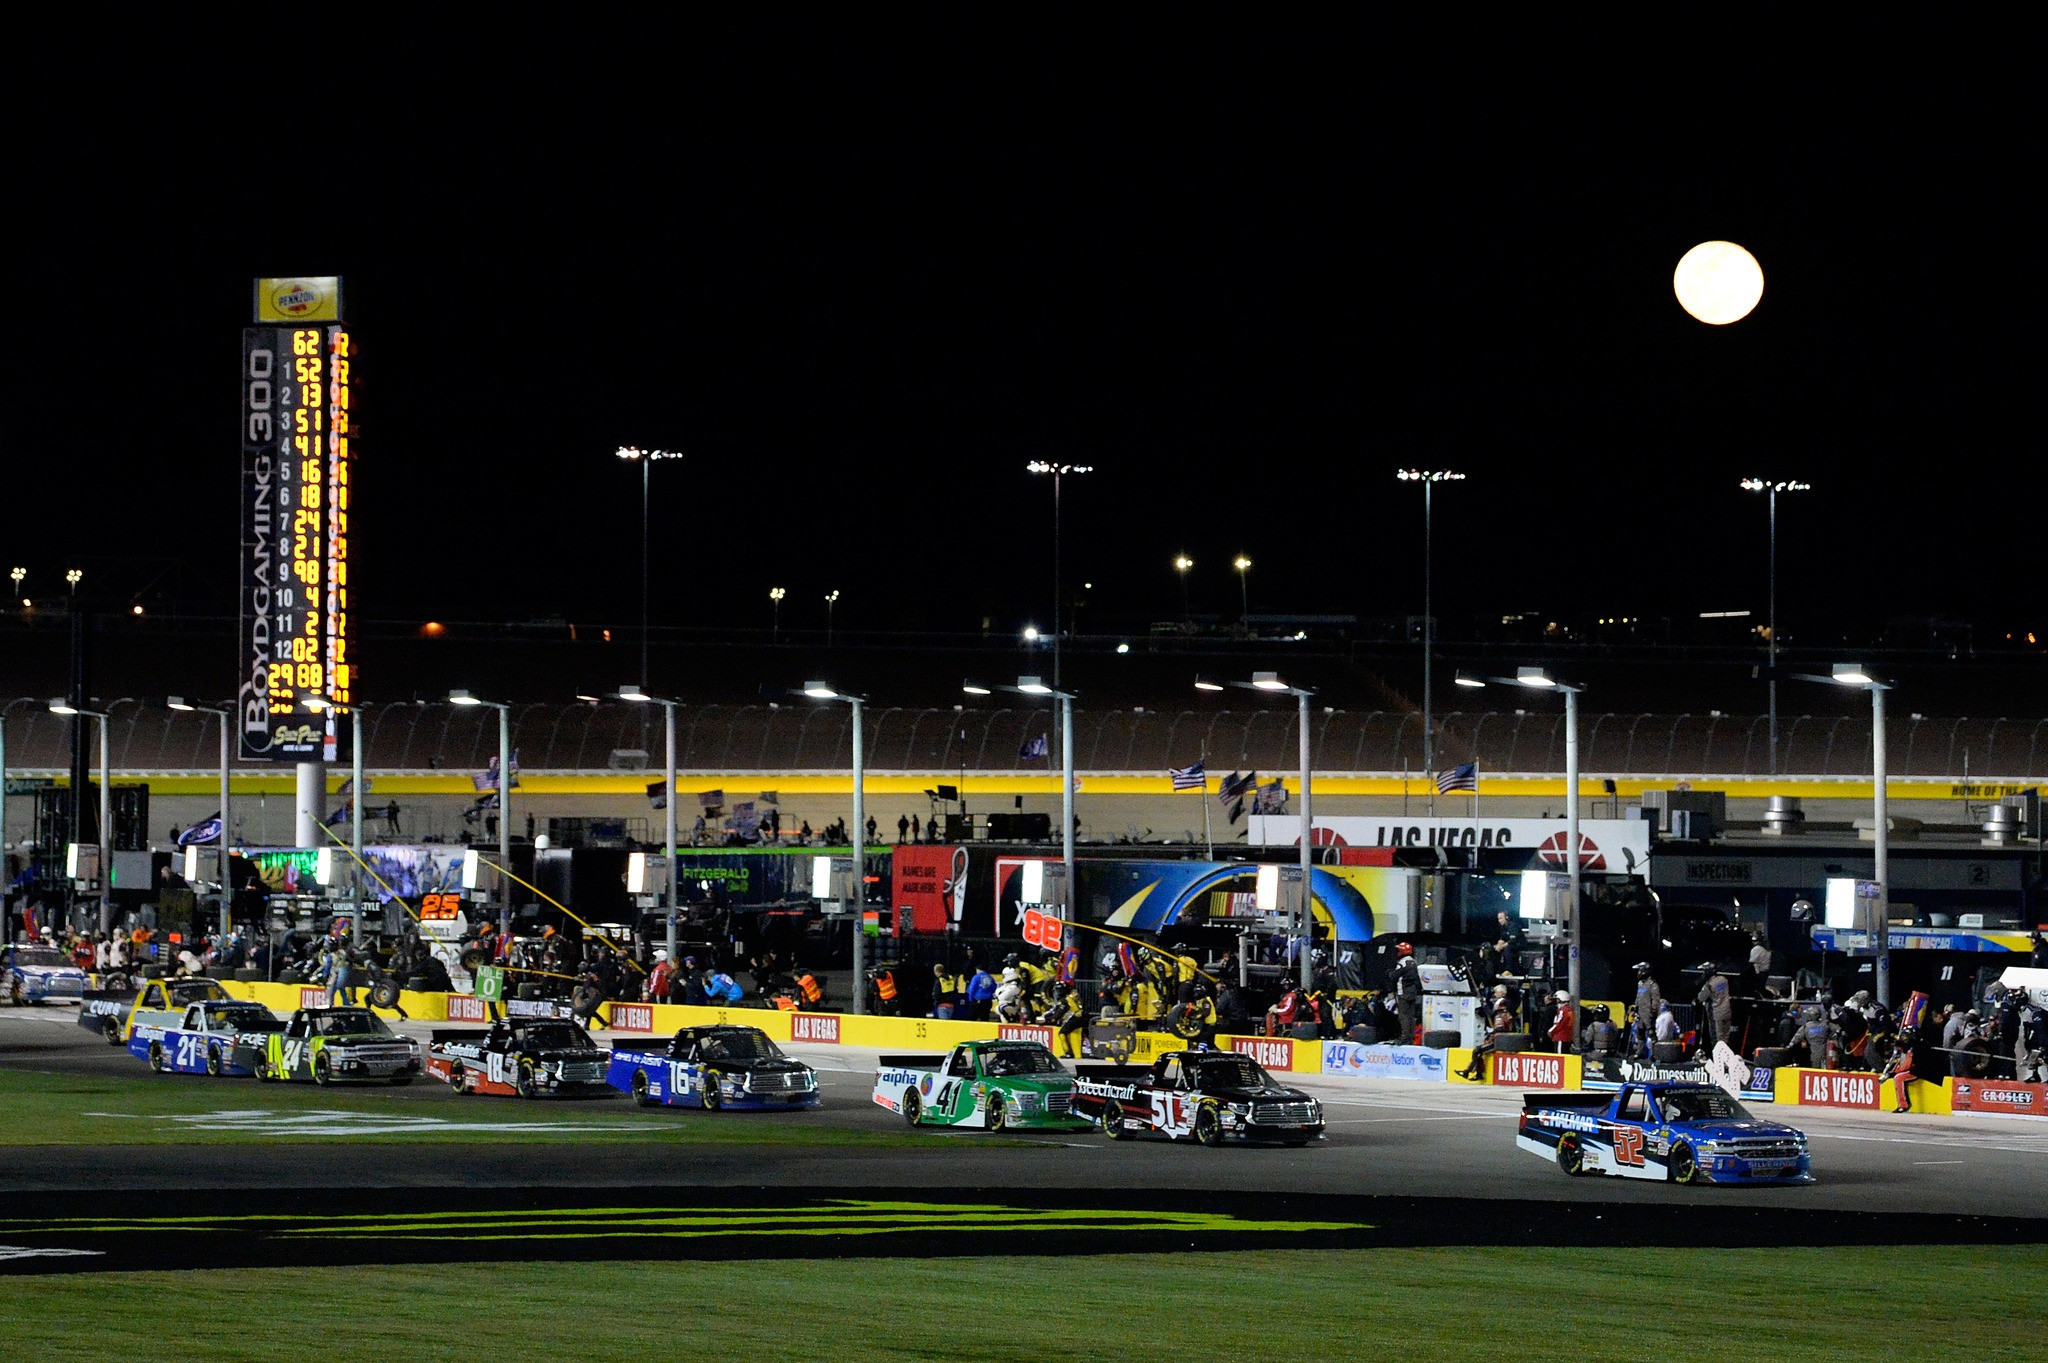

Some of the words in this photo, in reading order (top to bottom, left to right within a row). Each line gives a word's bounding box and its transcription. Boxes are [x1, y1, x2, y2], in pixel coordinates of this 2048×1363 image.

[278, 291, 315, 306] PENNZOIL
[293, 330, 320, 356] 62
[283, 361, 291, 380] 1
[295, 357, 322, 383] 52
[249, 349, 273, 442] 300
[281, 388, 291, 405] 2
[302, 382, 322, 408] 13
[281, 411, 291, 431] 3
[295, 408, 322, 433] 51
[281, 436, 291, 456] 4
[295, 435, 322, 457] 41
[281, 462, 290, 481] 5
[301, 458, 321, 484] 16
[280, 487, 290, 506] 6
[301, 483, 321, 509] 18
[281, 512, 289, 532] 7
[294, 509, 321, 534] 24
[280, 537, 289, 556] 8
[294, 534, 320, 560] 21
[279, 562, 289, 581] 9
[294, 560, 320, 585] 98
[275, 588, 293, 607] 10
[305, 586, 320, 608] 4
[276, 613, 293, 633] 11
[305, 611, 319, 636] 2
[275, 640, 293, 659] 12
[268, 663, 294, 689] 29
[1952, 786, 1981, 796] HOME
[1984, 786, 1997, 796] OF
[1428, 827, 1512, 848] VEGAS
[683, 867, 749, 880] FITZGERALD
[1687, 863, 1750, 881] INSPECTIONS
[1973, 865, 1984, 882] 2
[420, 893, 461, 920] 25
[1920, 937, 1951, 950] NASCAR
[477, 965, 503, 979] MILE
[89, 1000, 121, 1016] CURB
[449, 998, 461, 1018] LAS
[463, 998, 483, 1019] VEGAS
[612, 1006, 625, 1027] LAS
[626, 1007, 650, 1030] VEGAS
[793, 1017, 810, 1039] LAS
[811, 1017, 838, 1041] VEGAS
[916, 1022, 927, 1038] 35
[1001, 1028, 1018, 1040] LAS
[1020, 1029, 1050, 1048] VEGAS
[177, 1035, 196, 1067] 21
[282, 1040, 303, 1072] 24
[1155, 1039, 1183, 1050] POWERING
[1235, 1041, 1253, 1060] LAS
[1255, 1043, 1288, 1067] VEGAS
[486, 1052, 504, 1083] 18
[1326, 1045, 1348, 1071] 49
[669, 1061, 690, 1095] 16
[1498, 1057, 1519, 1082] LAS
[1522, 1058, 1559, 1085] VEGAS
[1658, 1069, 1686, 1082] mess
[1686, 1068, 1708, 1082] with
[1751, 1067, 1772, 1090] 22
[936, 1080, 963, 1118] 41
[1077, 1076, 1135, 1101] Beechcraft
[1804, 1075, 1828, 1102] LAS
[1832, 1076, 1874, 1105] VEGAS
[1982, 1091, 2033, 1104] CROSLEY
[1151, 1090, 1176, 1129] 51
[1550, 1113, 1593, 1133] HALMAR
[1613, 1123, 1645, 1166] 52
[1748, 1160, 1797, 1169] SILVERADO
